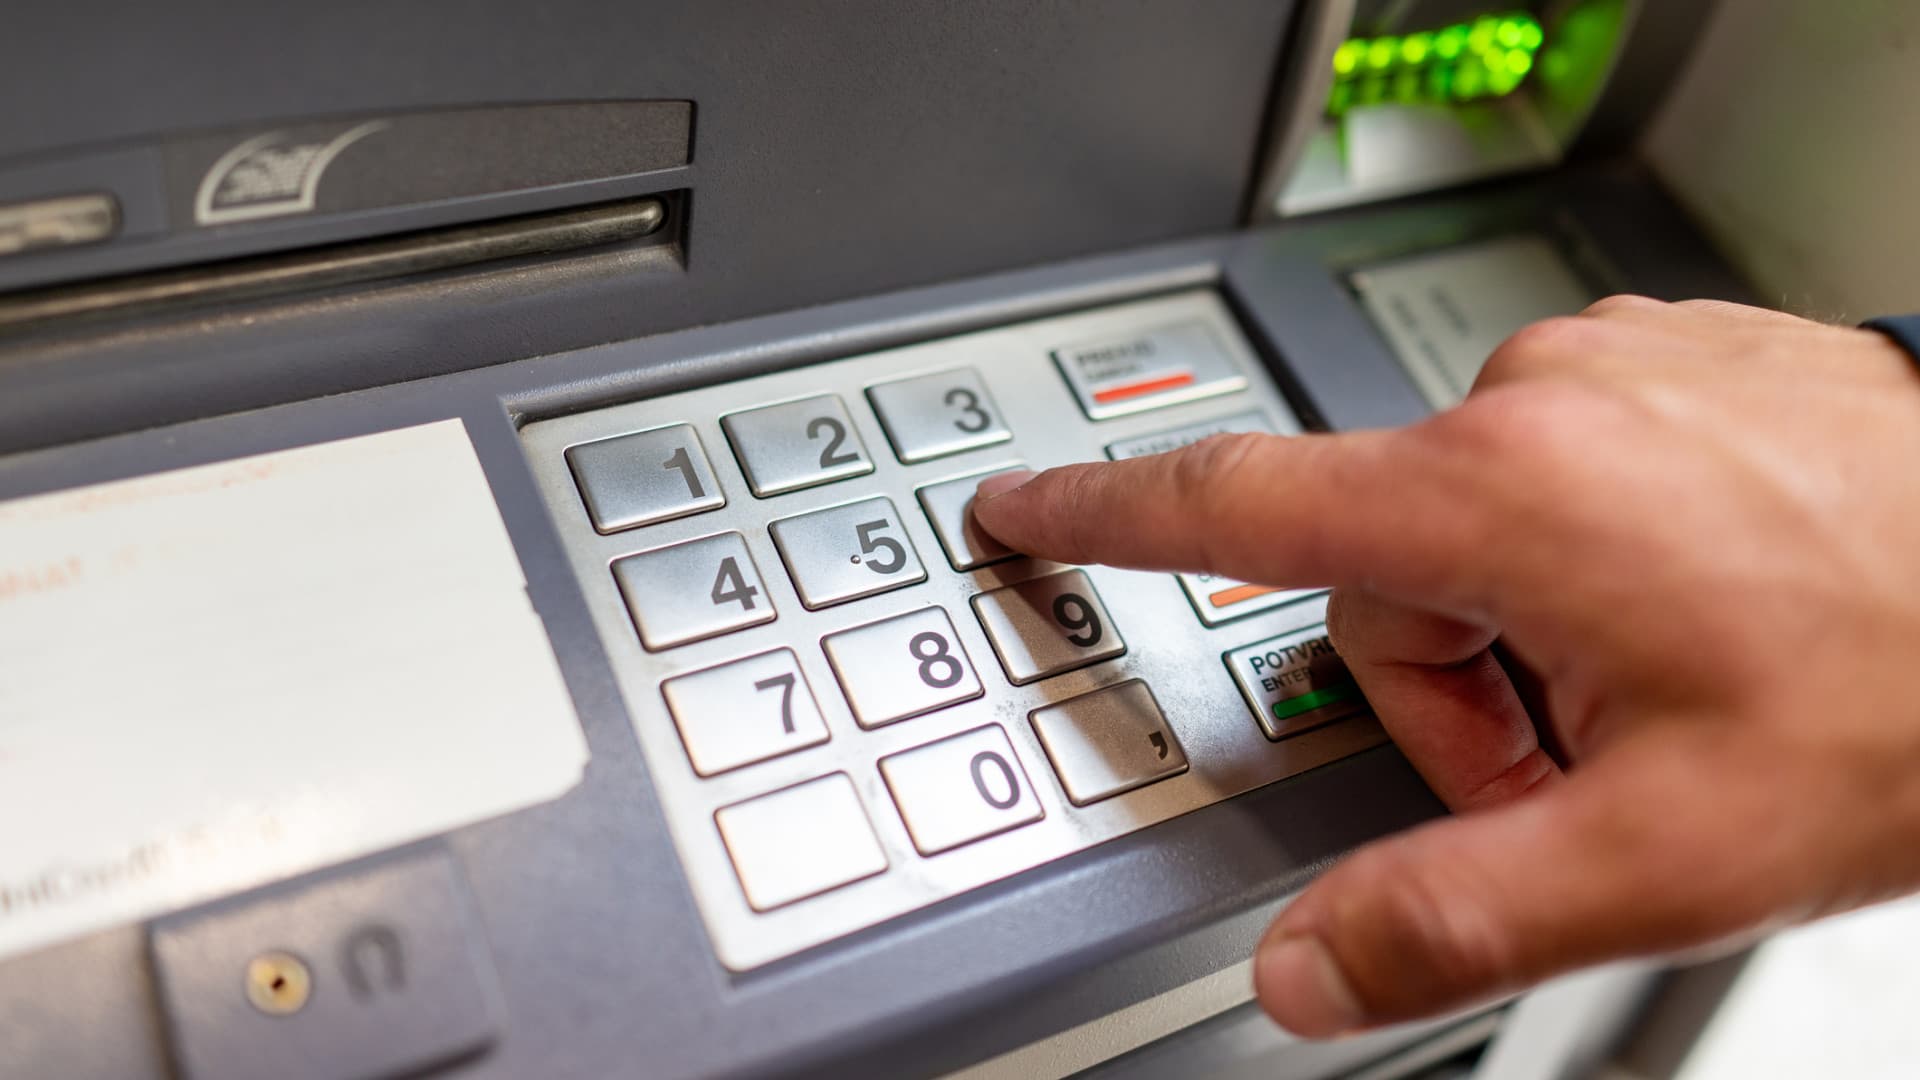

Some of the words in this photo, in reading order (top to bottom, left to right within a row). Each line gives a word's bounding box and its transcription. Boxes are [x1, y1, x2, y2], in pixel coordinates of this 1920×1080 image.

[943, 388, 991, 433] 3
[806, 417, 860, 468] 2
[663, 448, 705, 498] 1
[857, 519, 906, 574] 5
[711, 557, 758, 610] 4
[1053, 593, 1102, 648] 9
[909, 632, 963, 688] 8
[1261, 666, 1313, 692] ENTER
[755, 672, 796, 733] 7
[971, 751, 1020, 810] 0
